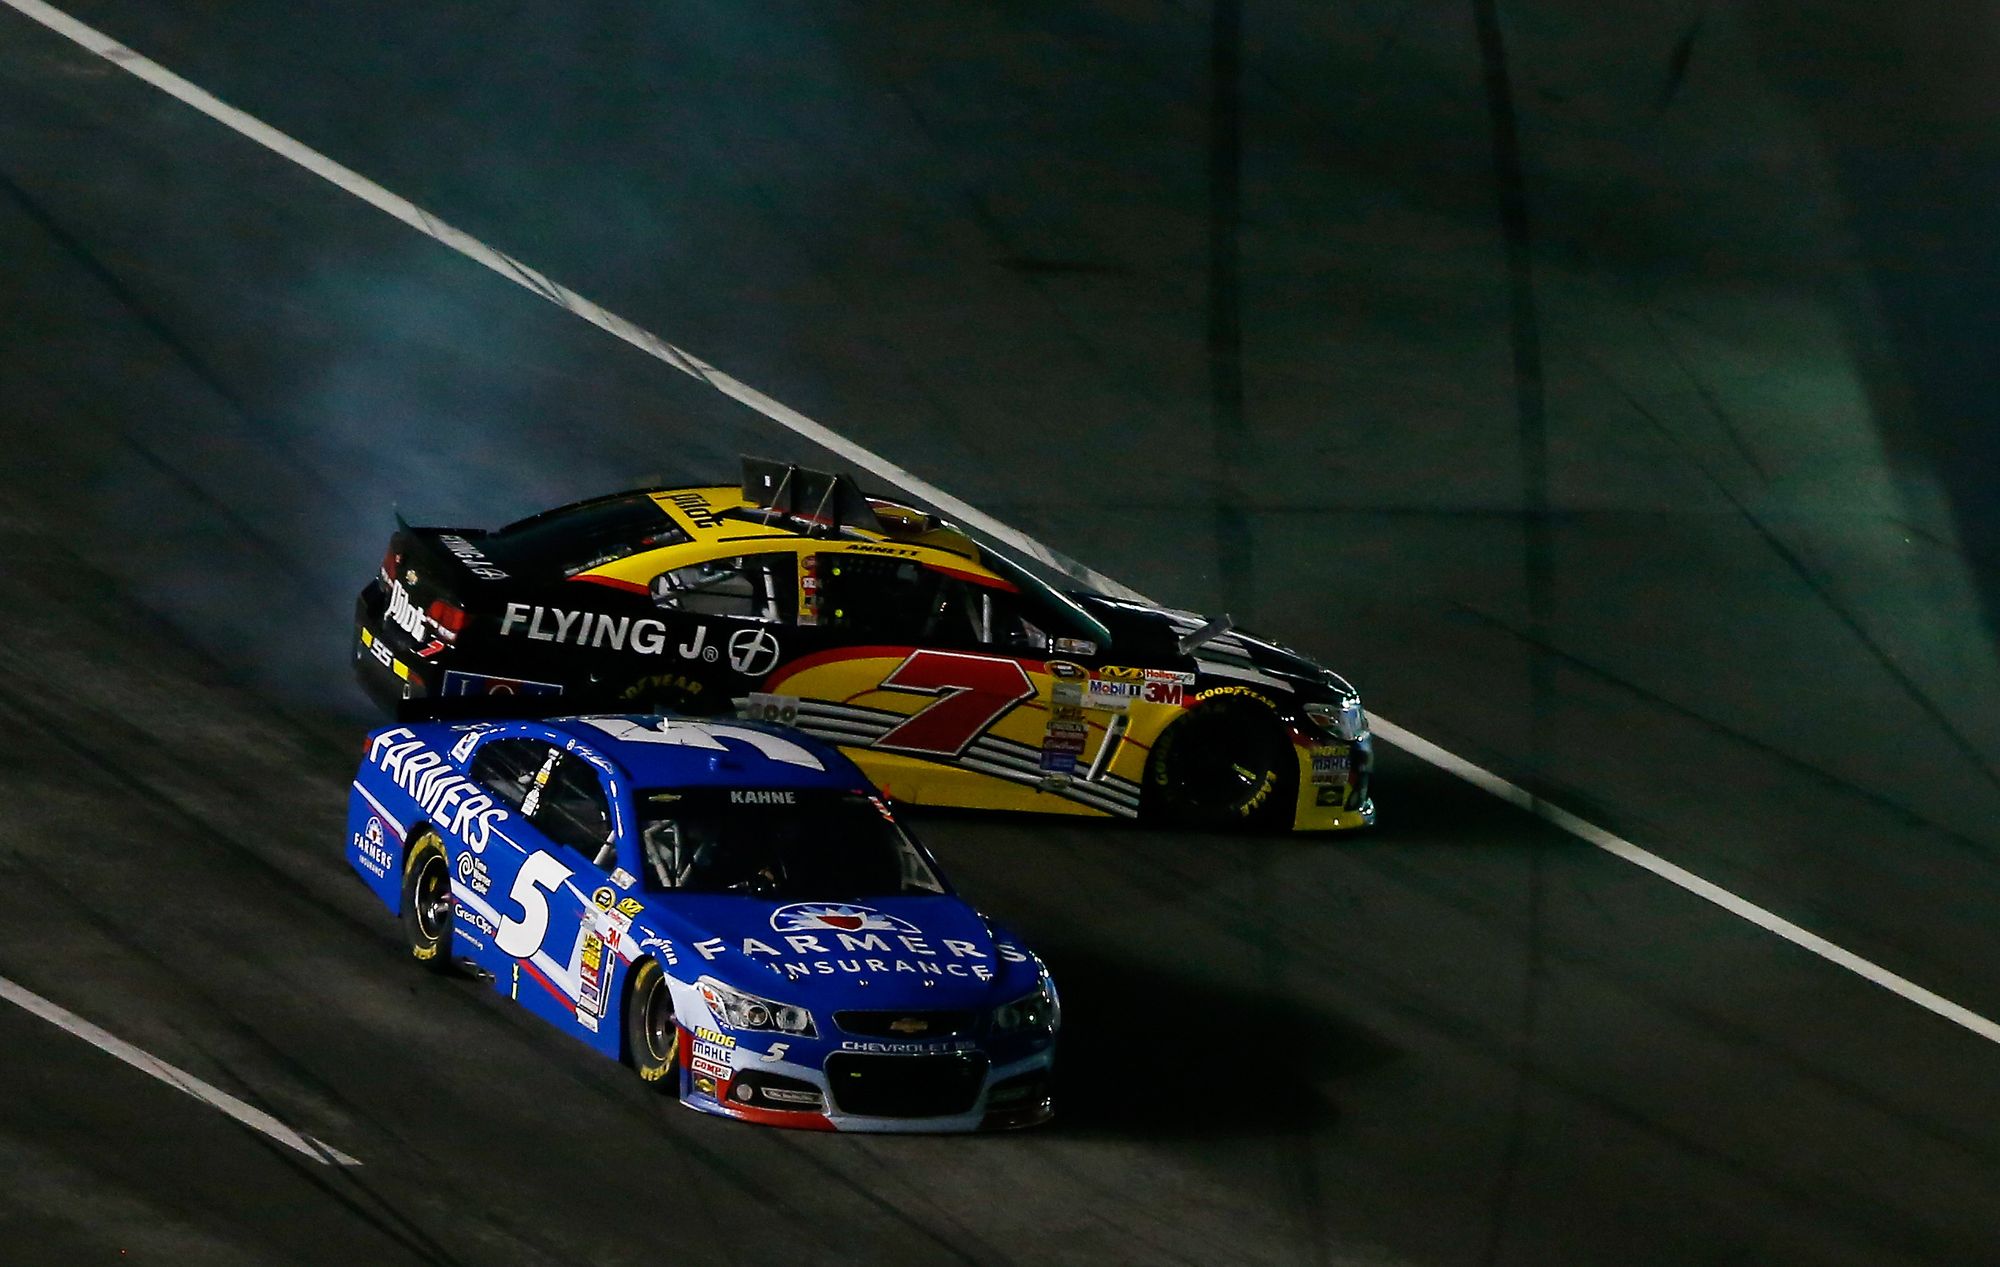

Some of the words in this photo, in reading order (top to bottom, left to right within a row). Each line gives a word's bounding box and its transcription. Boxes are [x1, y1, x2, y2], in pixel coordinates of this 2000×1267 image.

[500, 602, 666, 655] FLYING
[1090, 681, 1125, 697] Mobil
[1145, 683, 1181, 705] 3M
[871, 648, 1039, 758] 7
[1194, 685, 1280, 716] GOODYEAR
[369, 727, 509, 854] FARMERS
[730, 791, 796, 806] KAHNE
[353, 832, 393, 870] FARMERS
[494, 849, 576, 958] 5
[606, 927, 621, 950] 3M
[693, 933, 1027, 963] FARMERS
[770, 957, 994, 978] INSURANCE
[696, 1026, 735, 1048] MOOG
[842, 1041, 949, 1053] CHEVROLET
[694, 1042, 732, 1063] MAHLE
[760, 1042, 790, 1063] 5
[694, 1059, 722, 1075] COMP
